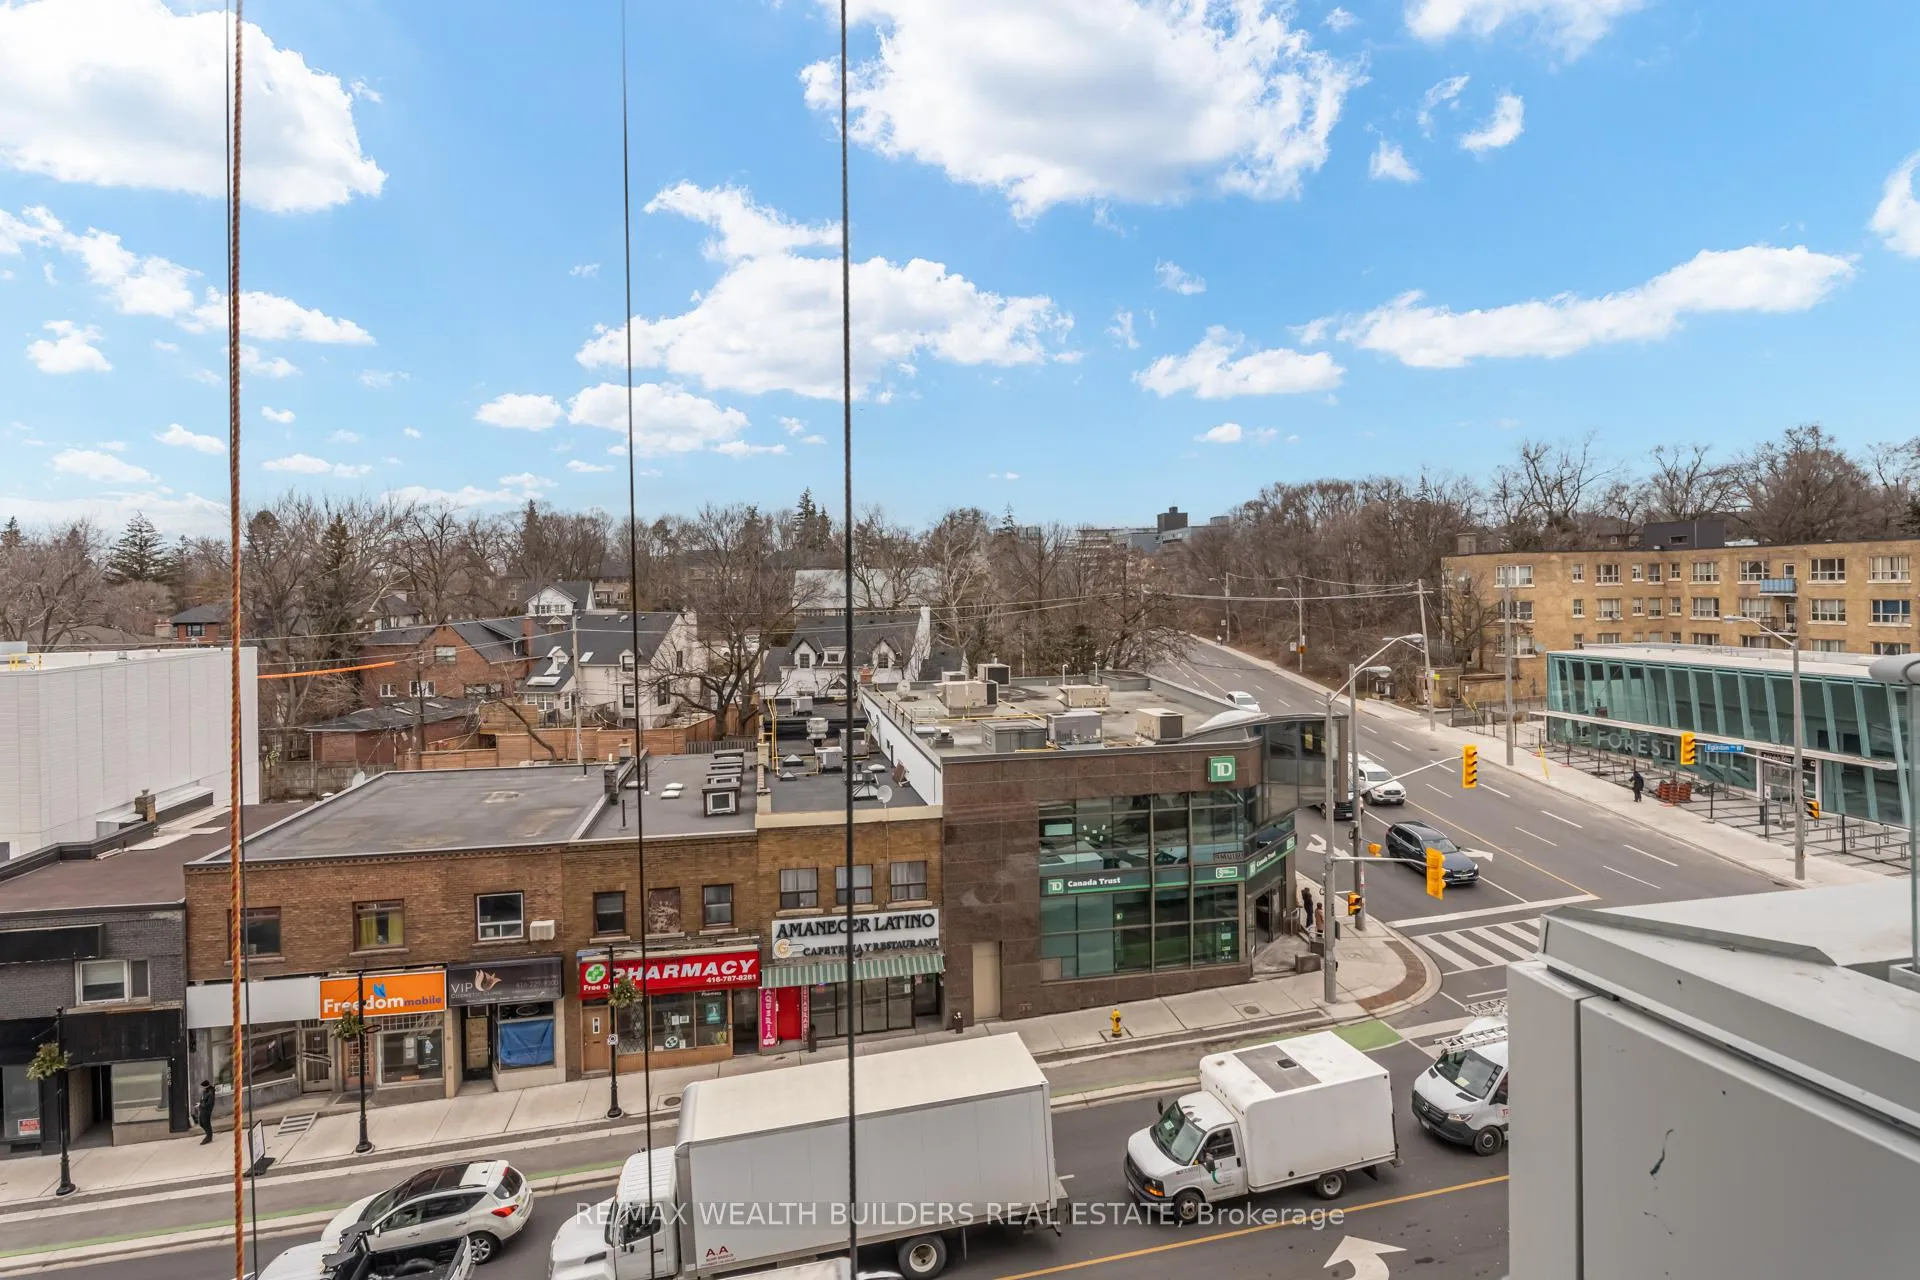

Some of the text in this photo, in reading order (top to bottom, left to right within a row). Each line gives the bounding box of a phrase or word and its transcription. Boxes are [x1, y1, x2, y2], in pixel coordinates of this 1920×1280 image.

[1597, 731, 1675, 759] FOREST
[1213, 762, 1233, 777] TD
[1051, 877, 1121, 891] TD Canada Trust
[776, 913, 935, 938] AMANECER LATINO
[873, 938, 938, 951] RESTAURANT
[609, 958, 756, 984] PHARMACY
[450, 982, 473, 993] VIP
[583, 983, 601, 991] Free
[323, 995, 442, 1014] Freedom mobile
